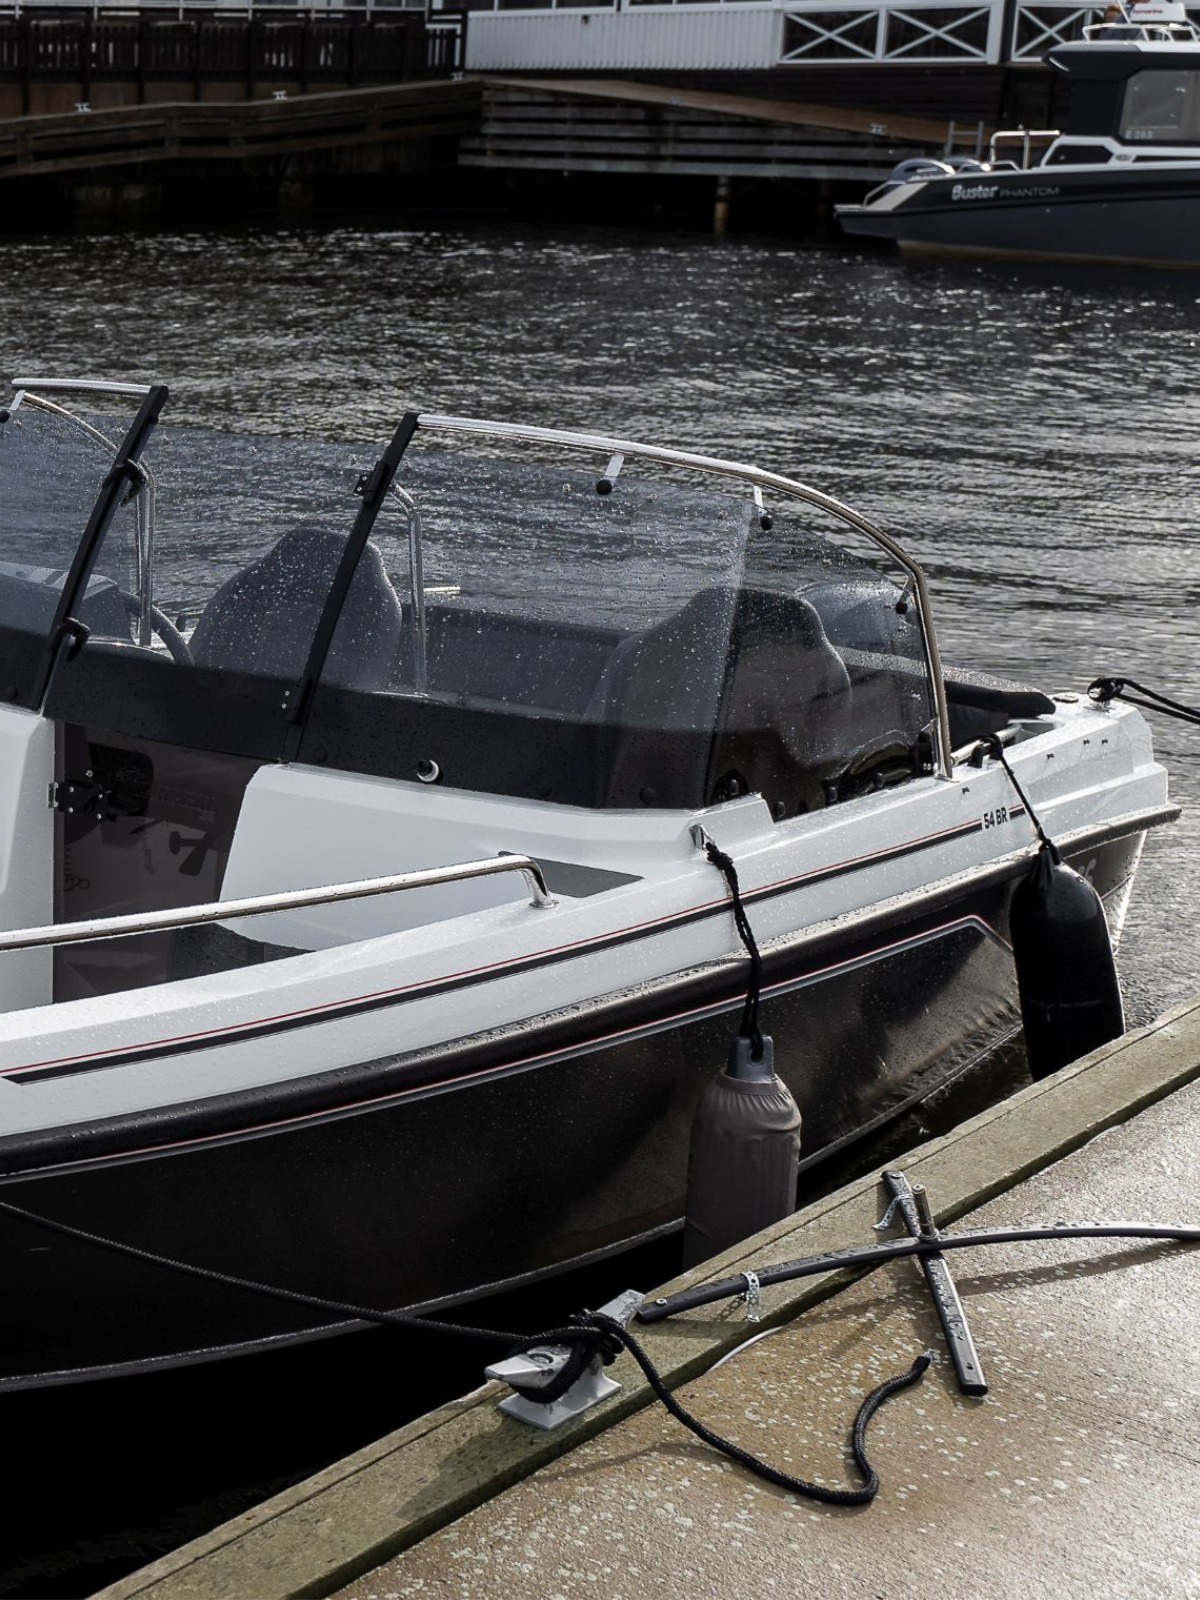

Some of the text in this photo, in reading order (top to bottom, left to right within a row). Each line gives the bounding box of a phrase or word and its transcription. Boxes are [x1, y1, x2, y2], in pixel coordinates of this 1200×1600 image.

[952, 185, 1060, 200] Buster PHANTOM
[983, 807, 1008, 829] 54 BR
